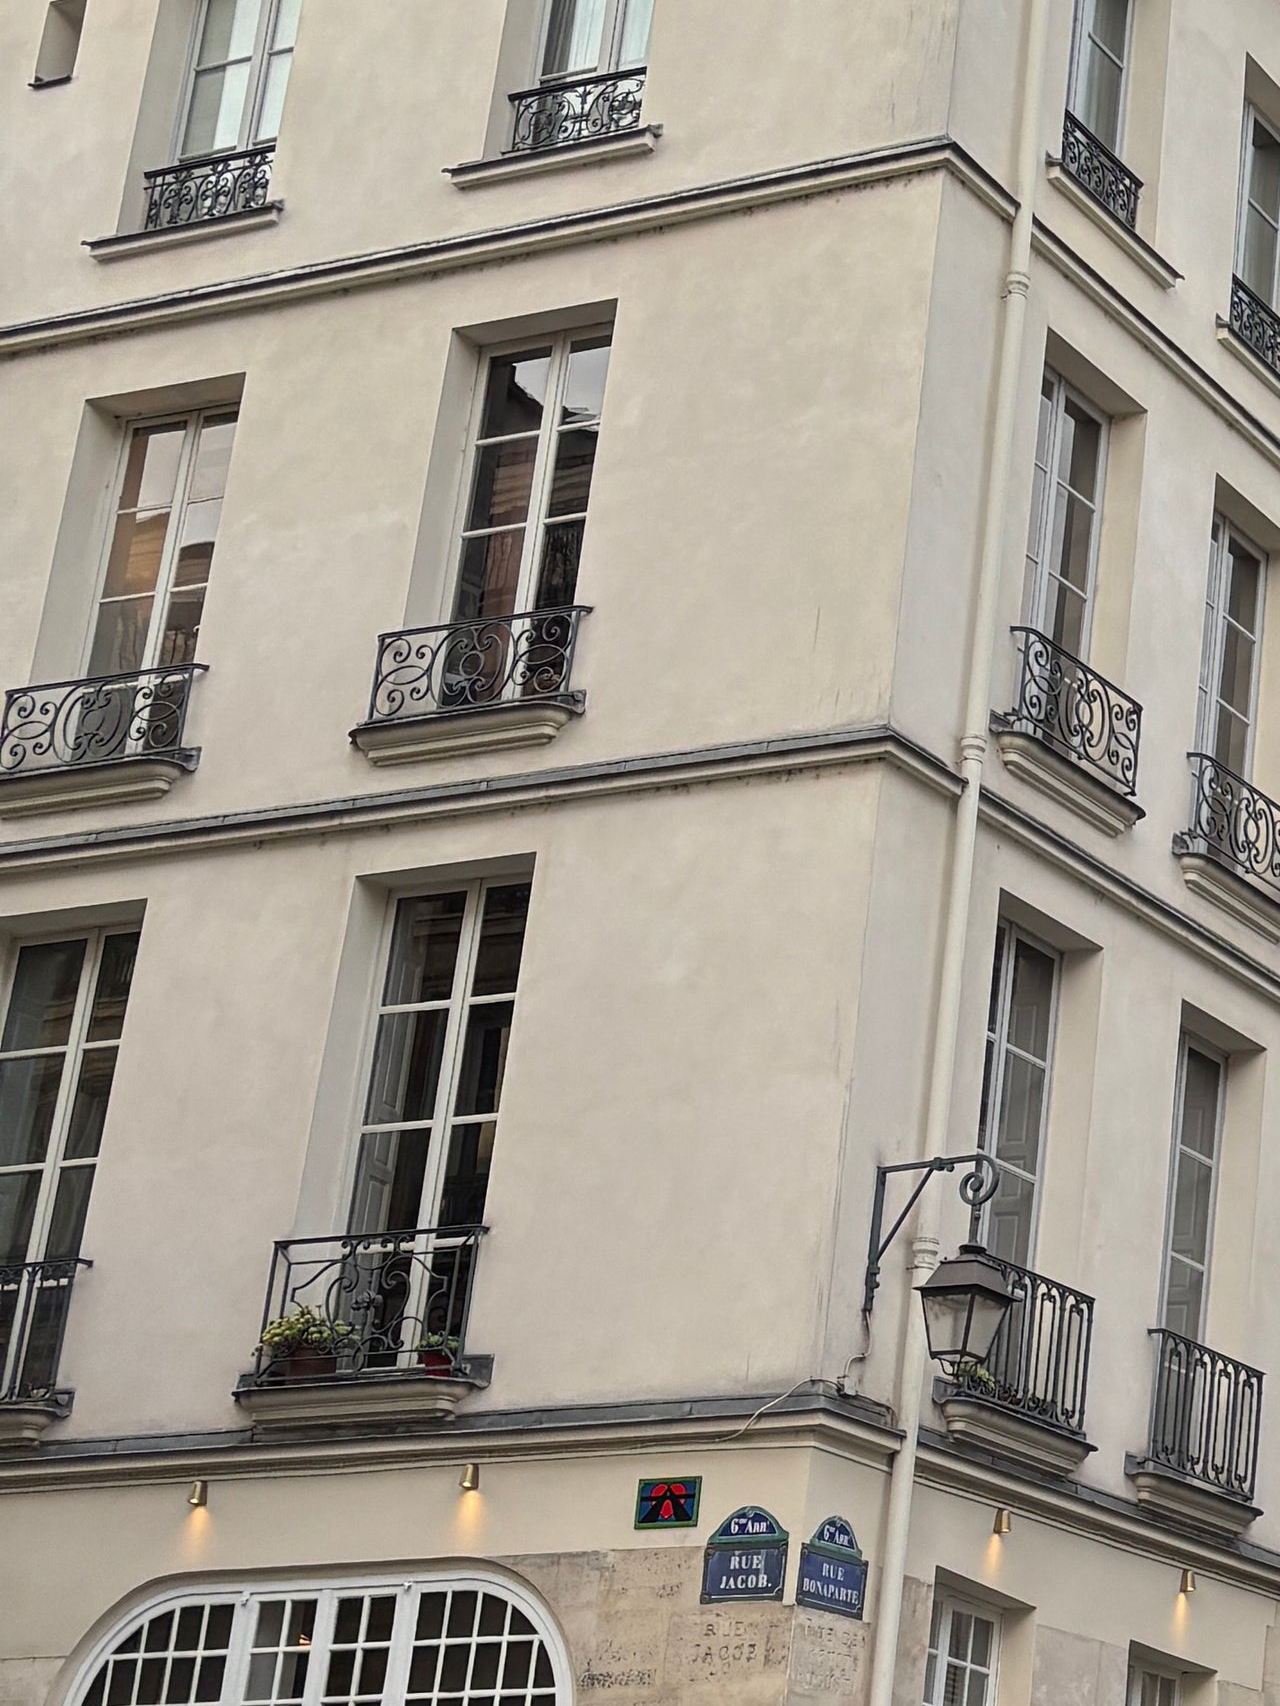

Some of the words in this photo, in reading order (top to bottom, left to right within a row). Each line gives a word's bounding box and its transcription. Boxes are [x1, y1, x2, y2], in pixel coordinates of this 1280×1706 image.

[730, 1554, 762, 1570] RUE
[822, 1562, 845, 1581] RUE
[803, 1577, 860, 1605] BONAPARTE
